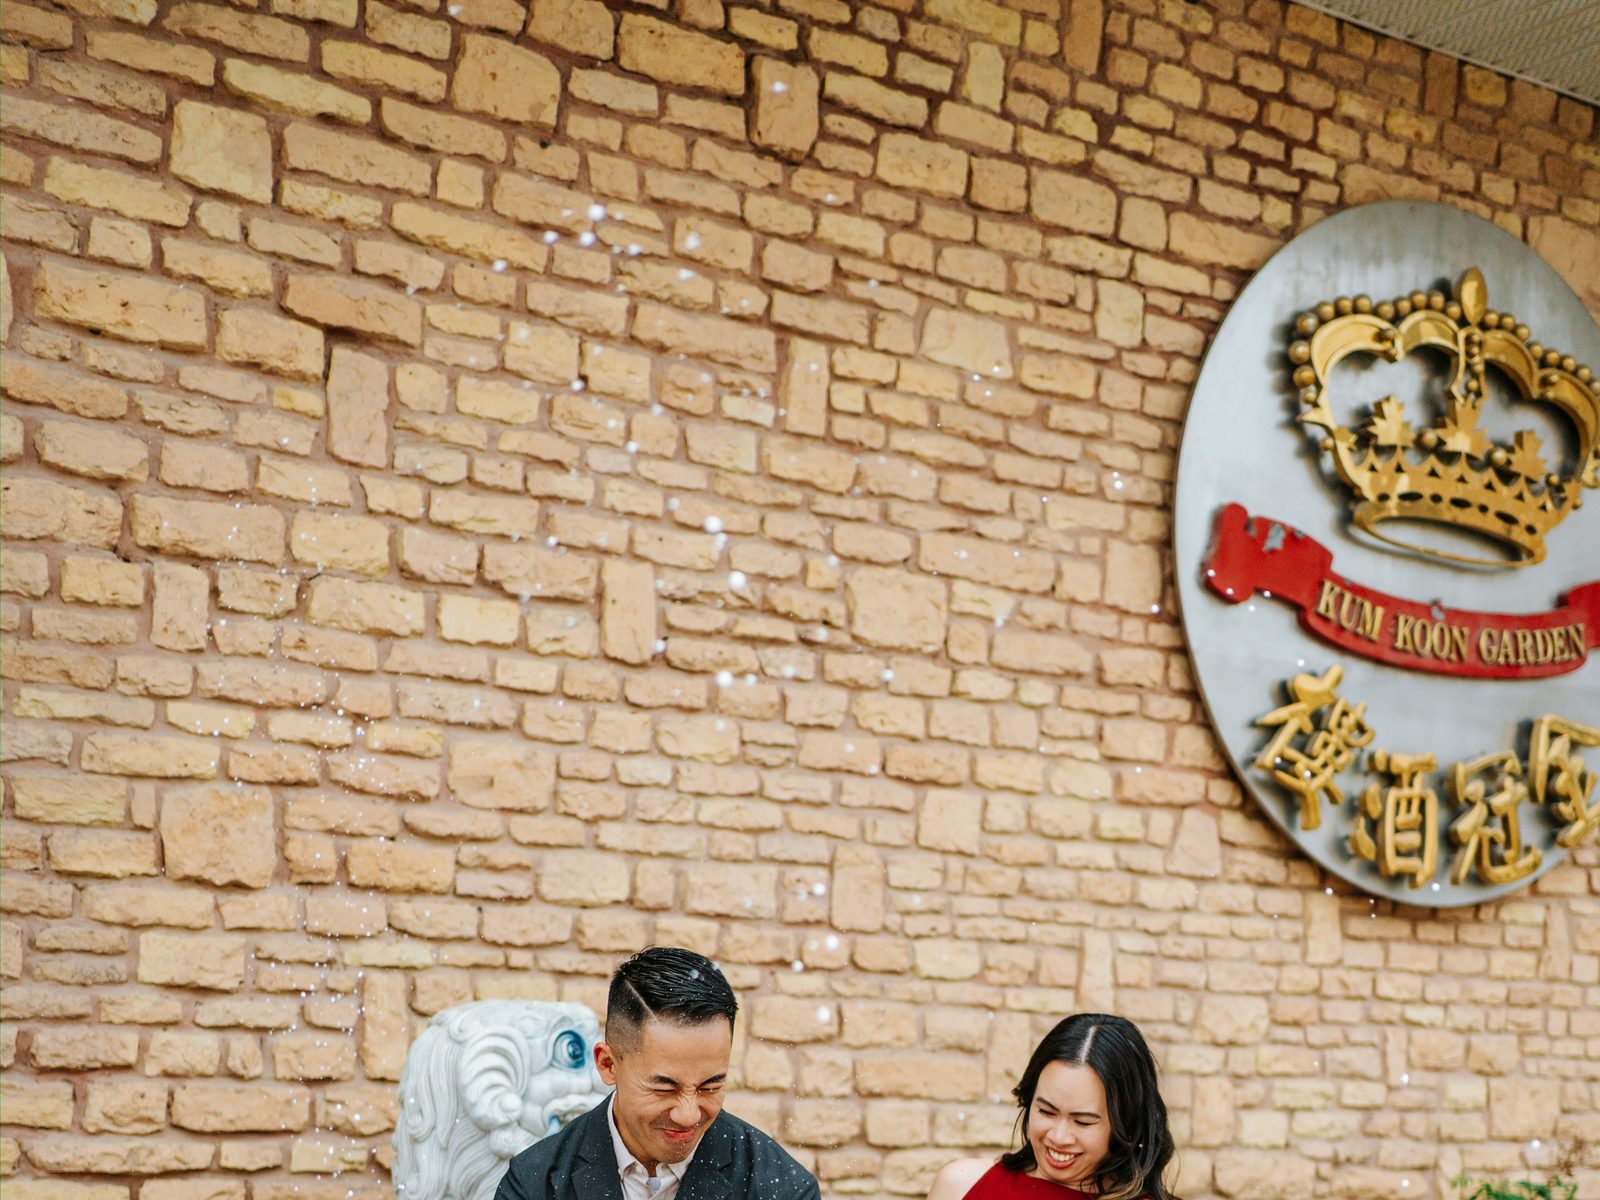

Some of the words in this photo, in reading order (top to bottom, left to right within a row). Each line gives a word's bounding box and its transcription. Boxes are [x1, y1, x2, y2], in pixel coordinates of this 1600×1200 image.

[1316, 579, 1384, 641] KUM
[1393, 613, 1469, 662] KOON
[1479, 623, 1585, 665] GARDEN
